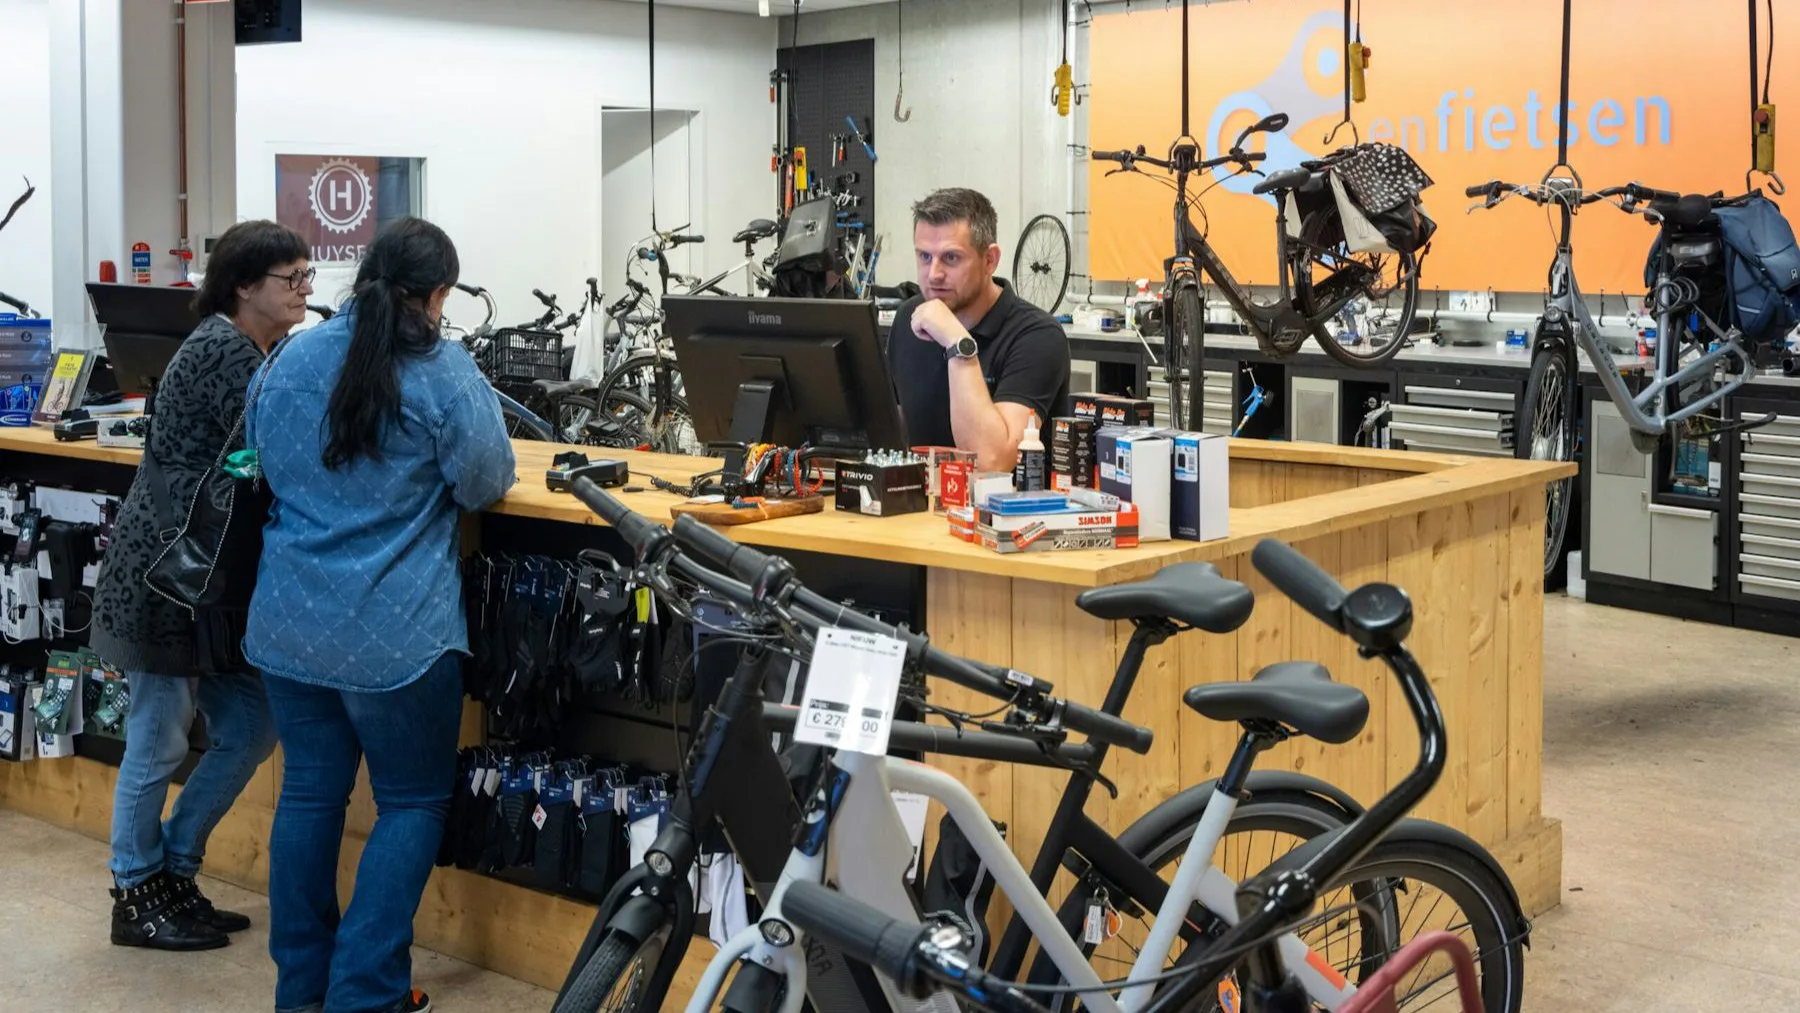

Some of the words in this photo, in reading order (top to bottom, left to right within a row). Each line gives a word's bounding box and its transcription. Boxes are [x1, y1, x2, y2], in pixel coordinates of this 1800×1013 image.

[329, 179, 352, 211] H
[748, 310, 782, 325] iiyama
[844, 470, 874, 482] TRIVIO
[1077, 515, 1112, 526] SIMSON
